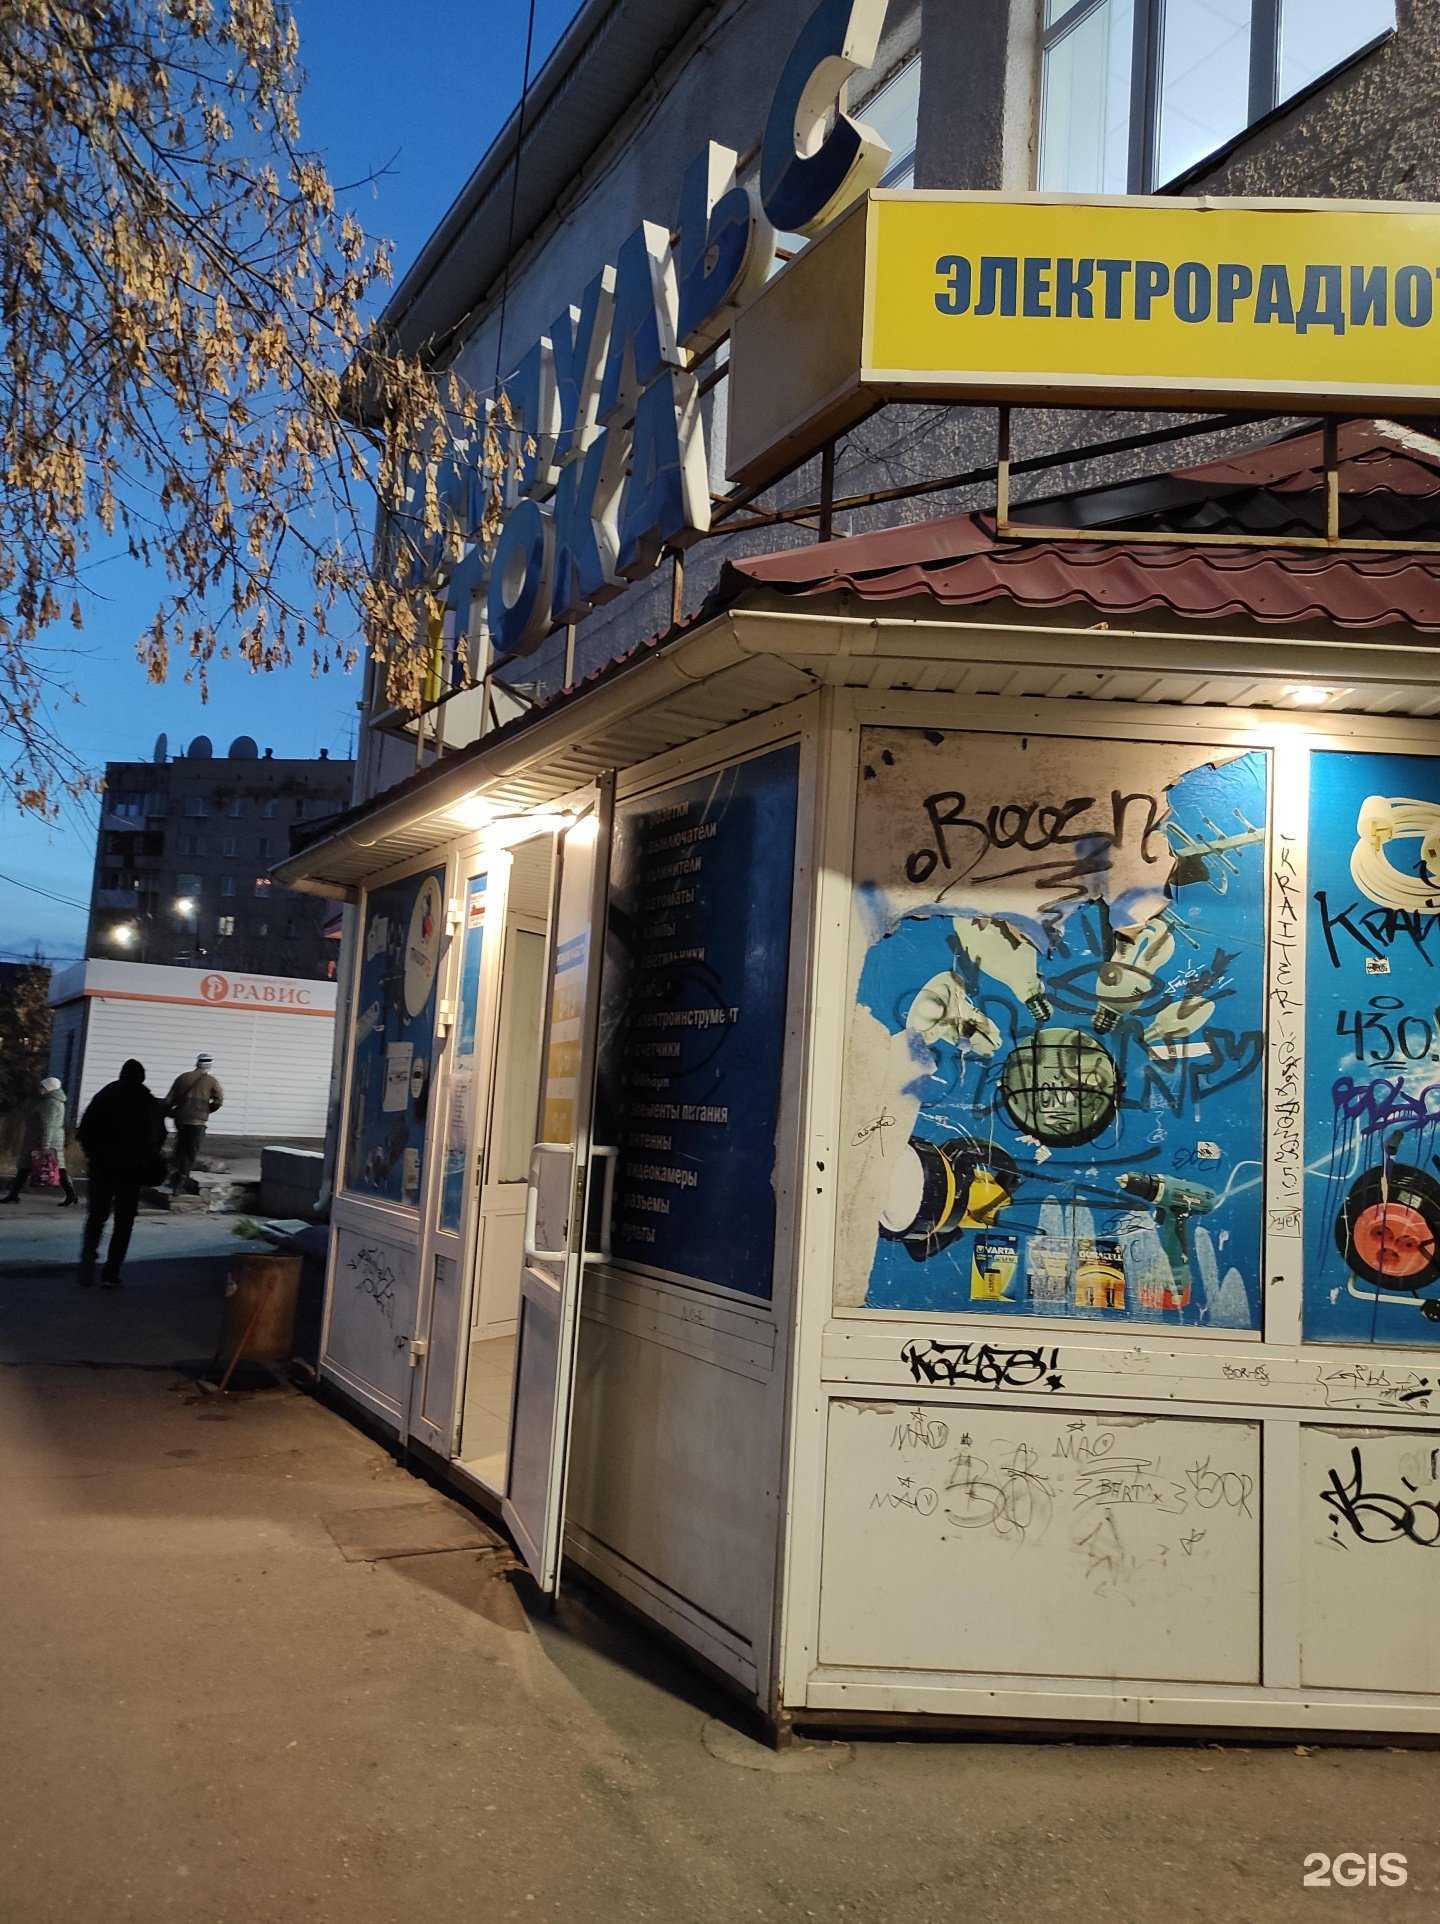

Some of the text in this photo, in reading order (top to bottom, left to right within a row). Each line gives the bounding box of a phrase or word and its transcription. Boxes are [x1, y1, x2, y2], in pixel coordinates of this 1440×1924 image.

[934, 253, 1440, 336] ЭЛЕКТРОРАДИО
[232, 982, 312, 1006] РАВИС
[985, 1246, 1016, 1255] VARTA
